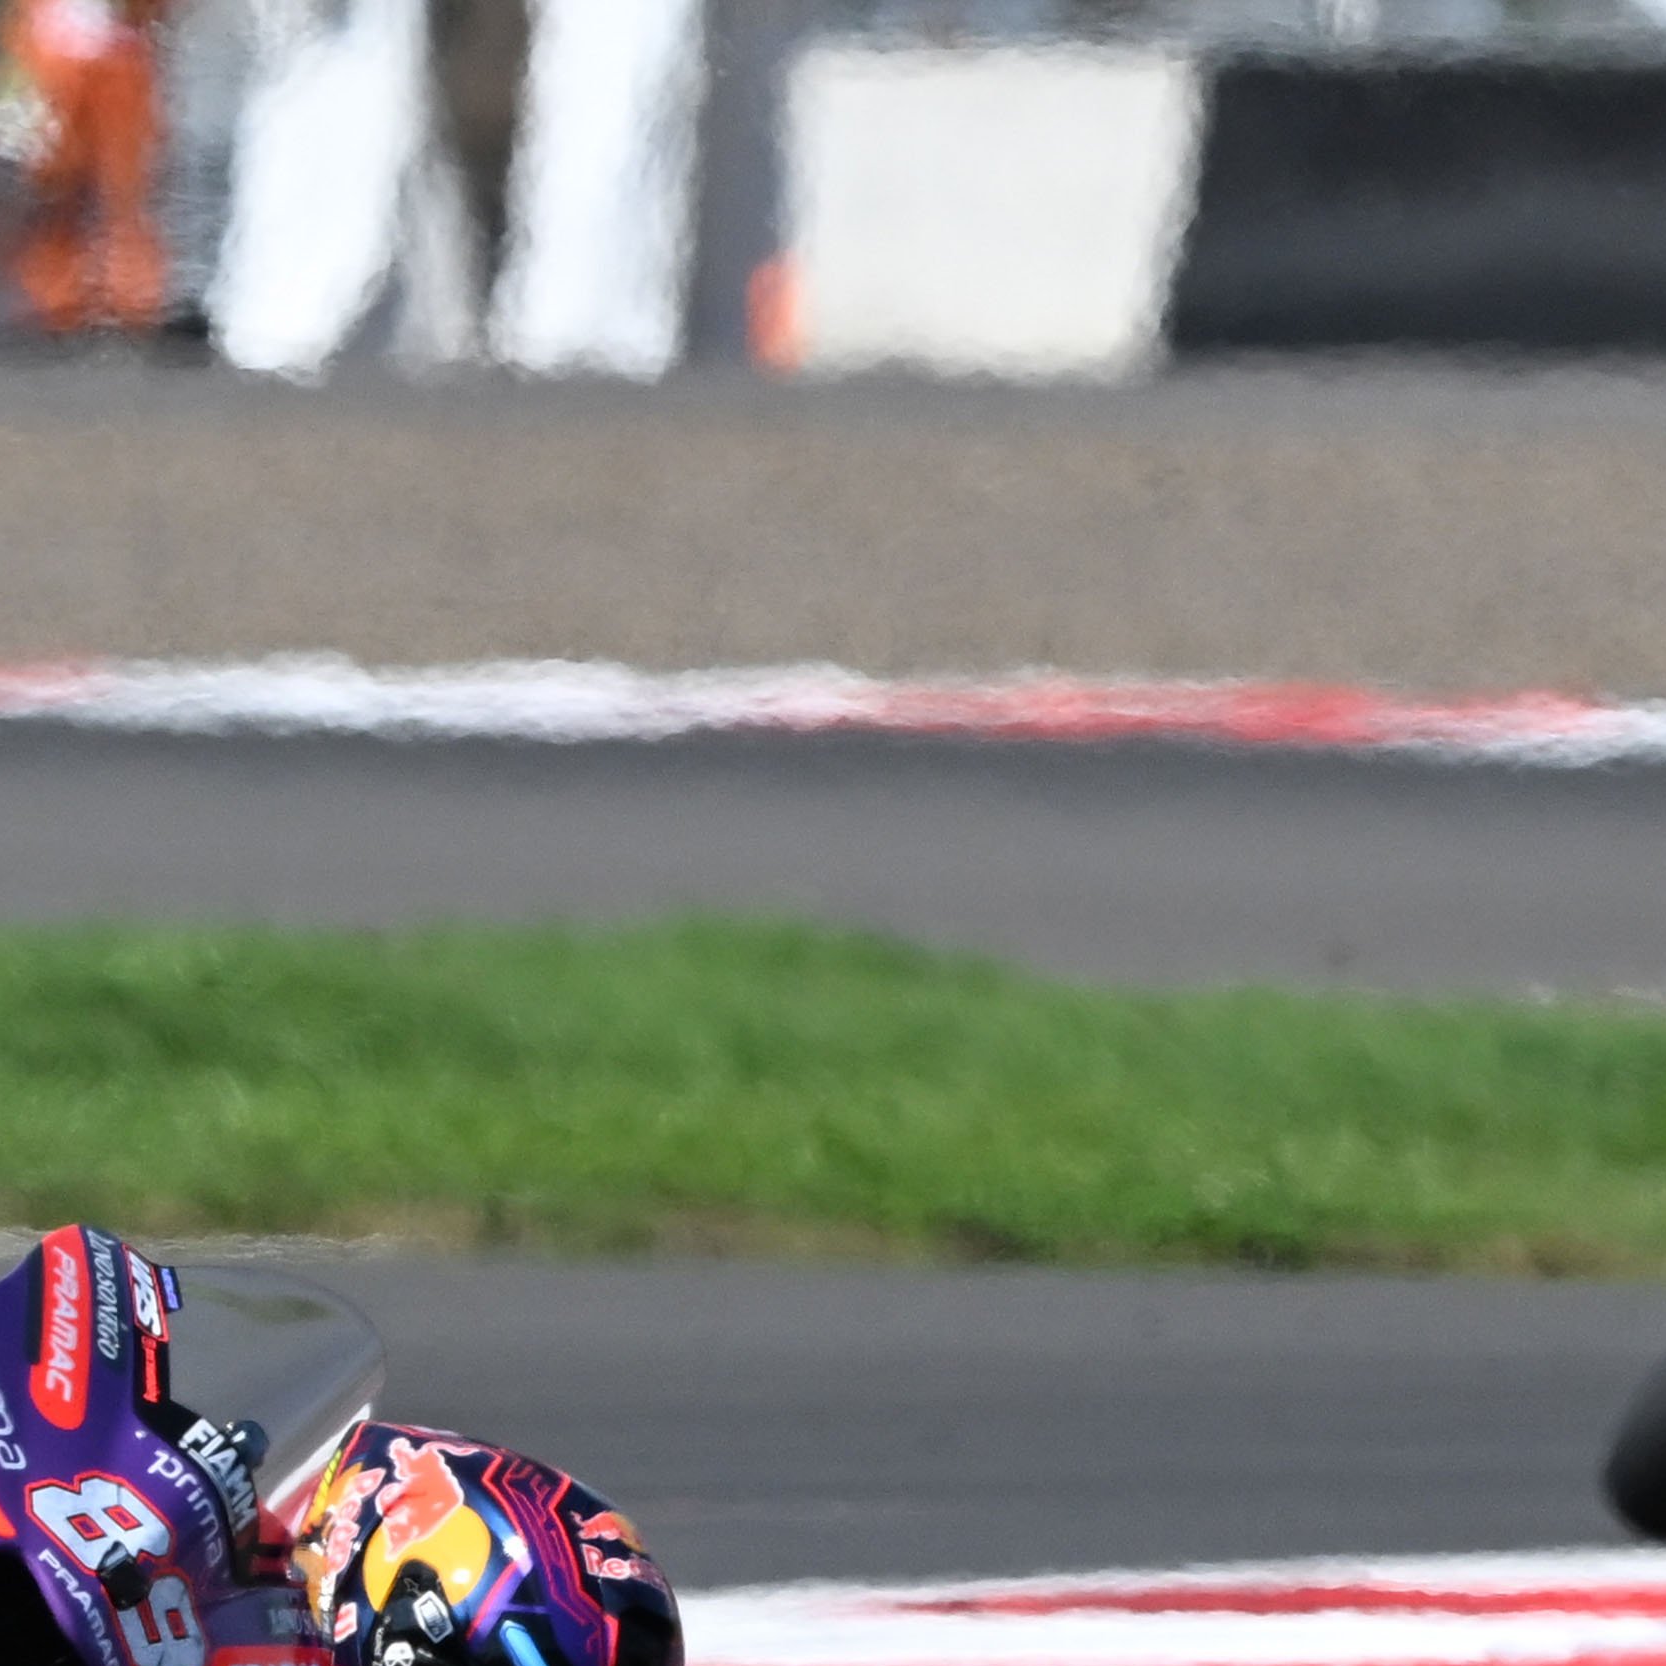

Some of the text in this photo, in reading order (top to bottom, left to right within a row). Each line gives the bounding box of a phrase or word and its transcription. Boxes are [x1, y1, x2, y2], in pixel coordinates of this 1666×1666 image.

[44, 1245, 80, 1402] PRAMAC
[147, 1450, 223, 1567] prima
[178, 1418, 258, 1531] FIAMM
